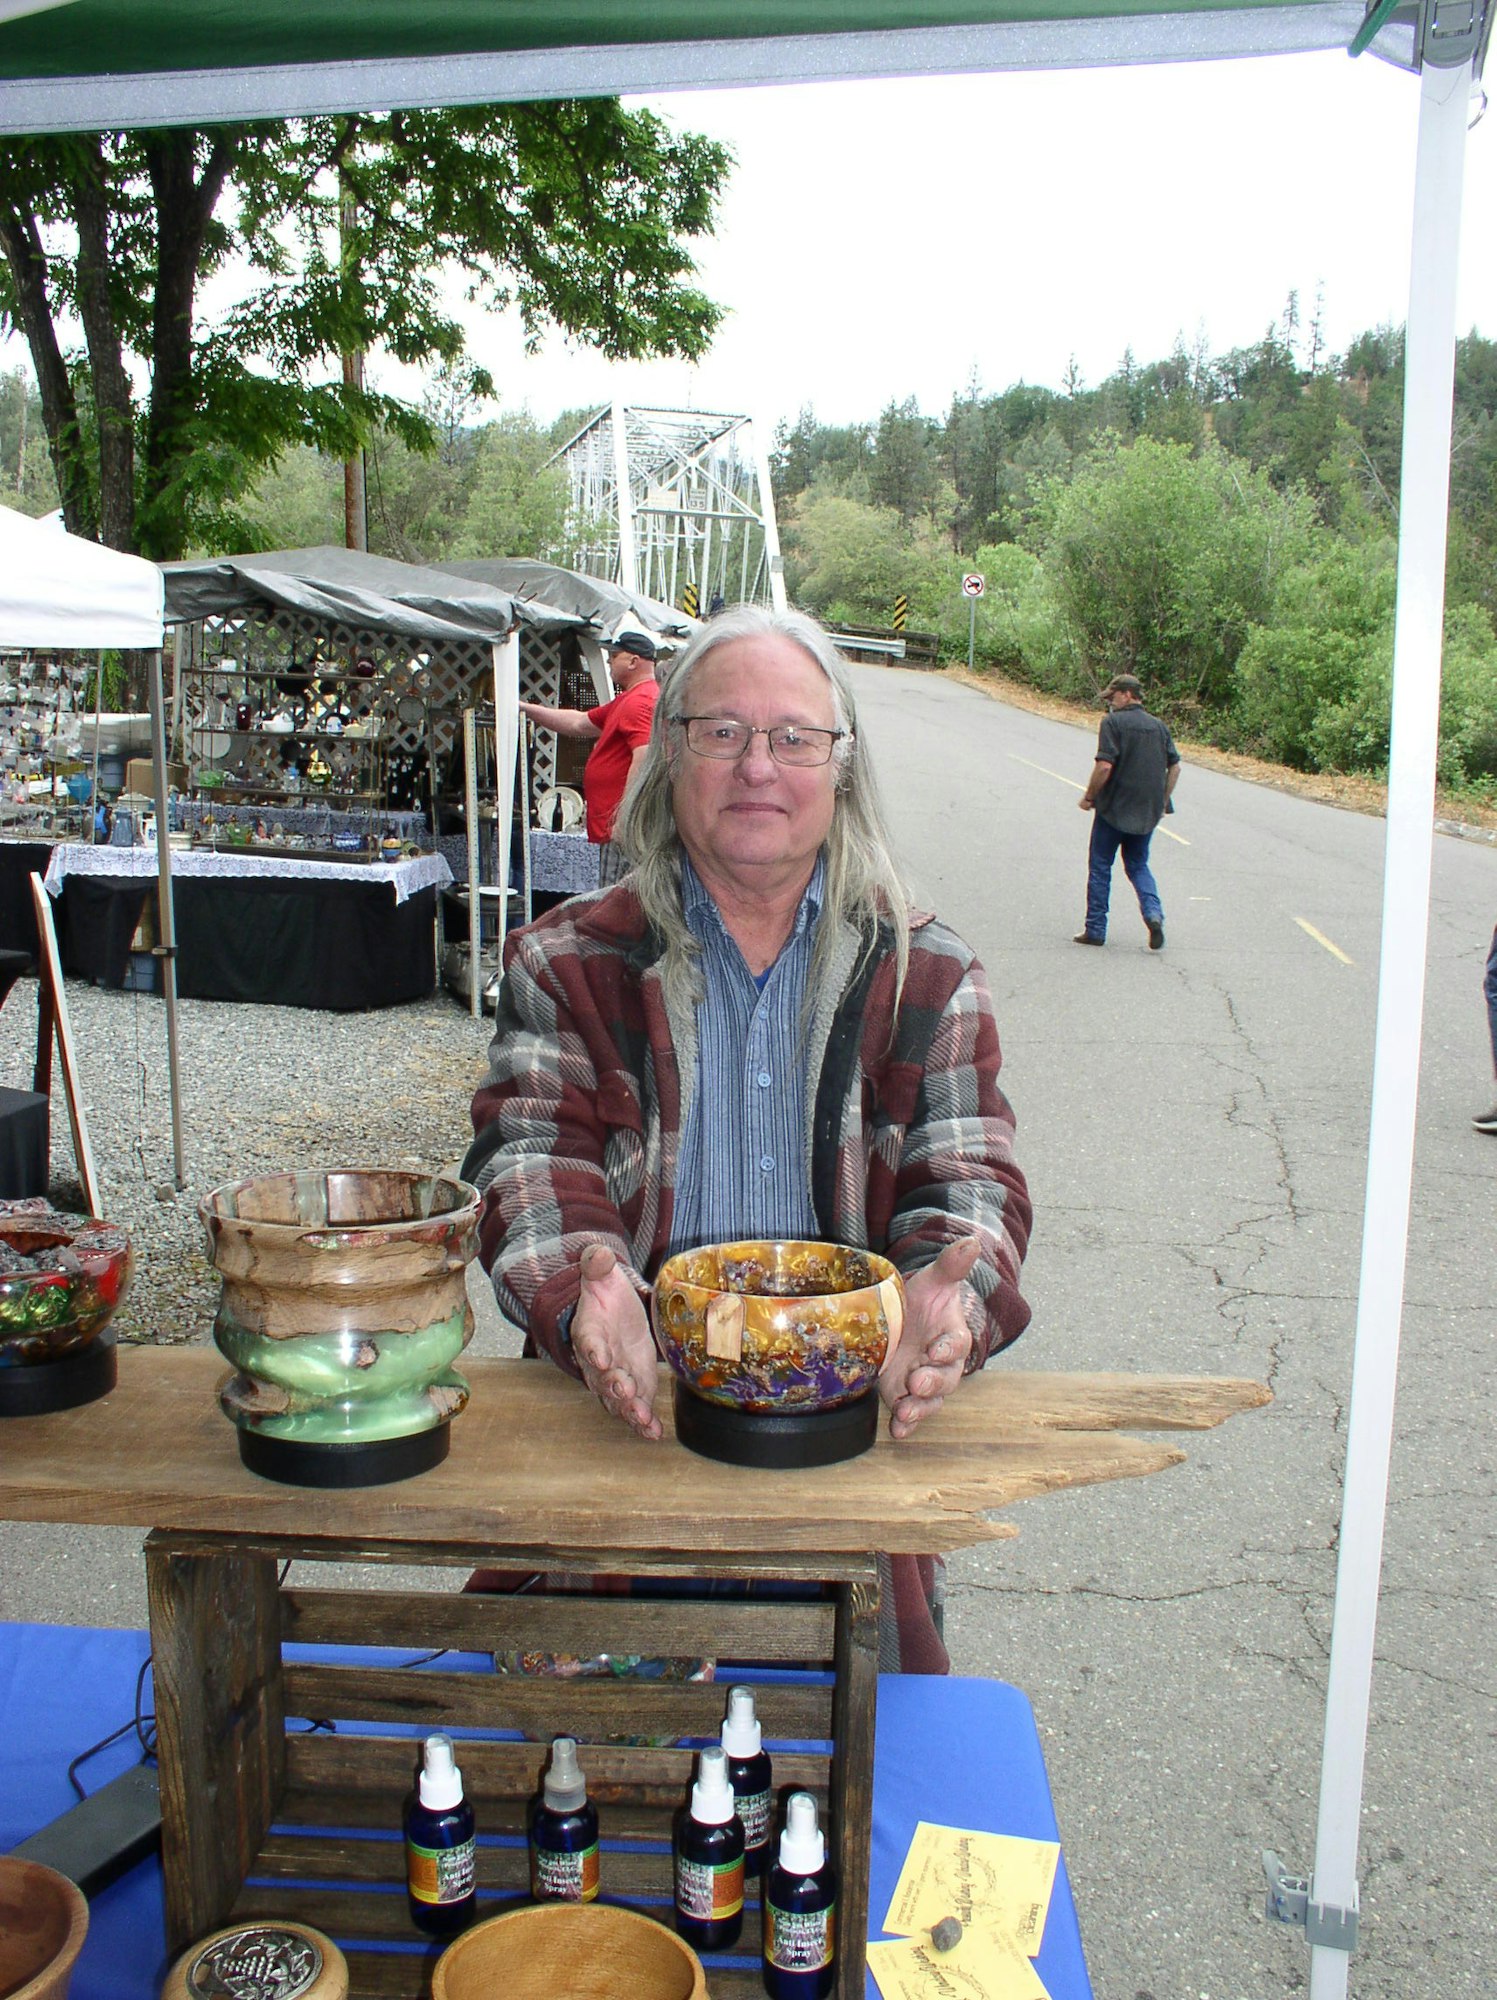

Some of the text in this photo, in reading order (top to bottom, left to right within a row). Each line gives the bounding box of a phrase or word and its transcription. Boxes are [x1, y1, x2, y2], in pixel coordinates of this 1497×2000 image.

[553, 1875, 580, 1885] Insect
[544, 1882, 567, 1895] Spray
[778, 1935, 823, 1948] Anti Insect
[786, 1947, 812, 1960] Spray
